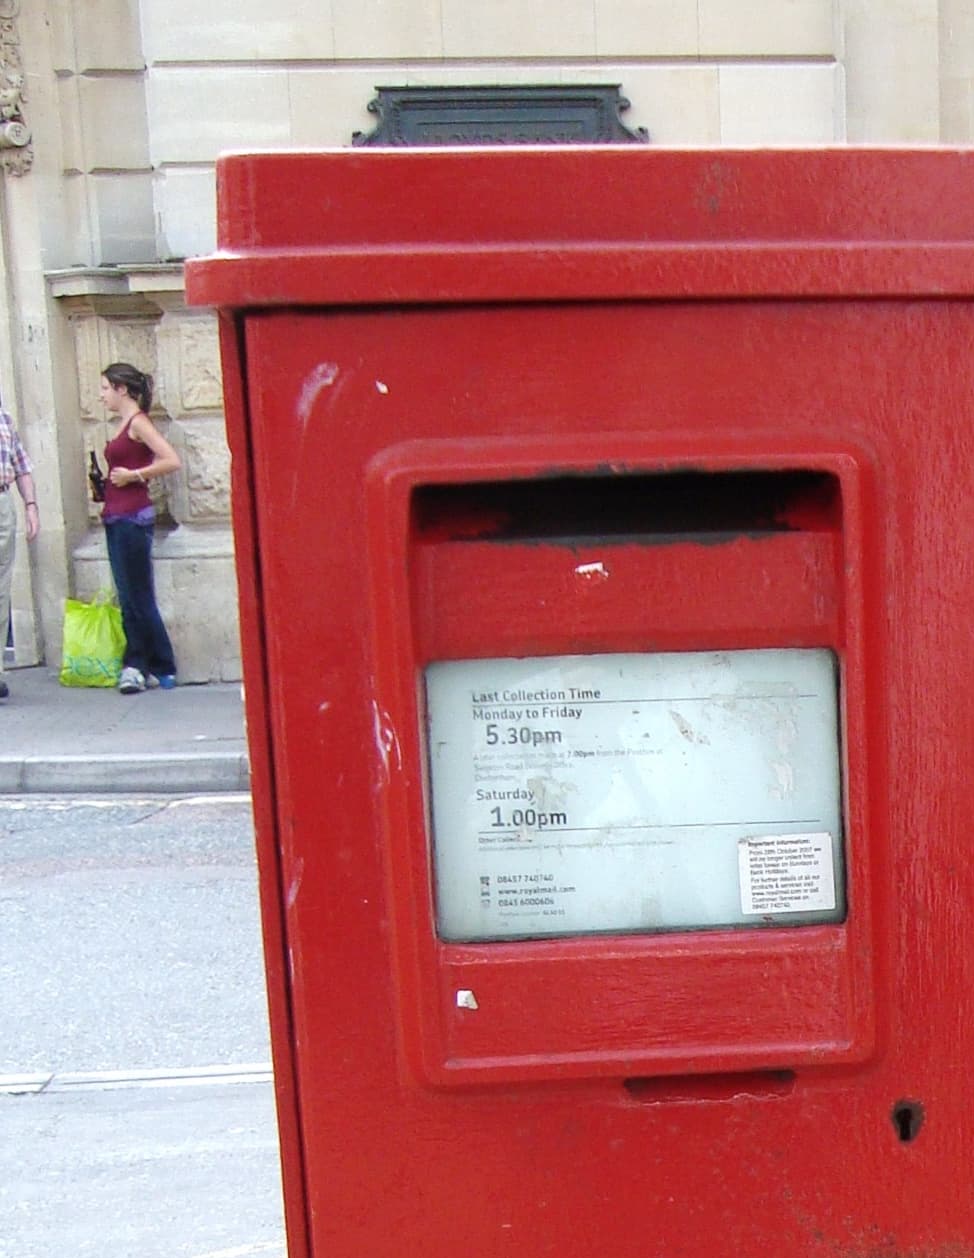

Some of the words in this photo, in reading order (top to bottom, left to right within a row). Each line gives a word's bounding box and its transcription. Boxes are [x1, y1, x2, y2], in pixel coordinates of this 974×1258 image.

[472, 690, 500, 703] Last
[502, 689, 566, 702] Collection
[568, 688, 601, 700] Time
[472, 707, 523, 721] Monday
[526, 709, 539, 719] to
[542, 706, 583, 719] Friday
[485, 724, 562, 747] 5.30pm
[476, 788, 535, 801] Saturday
[490, 806, 567, 829] 1.00pm
